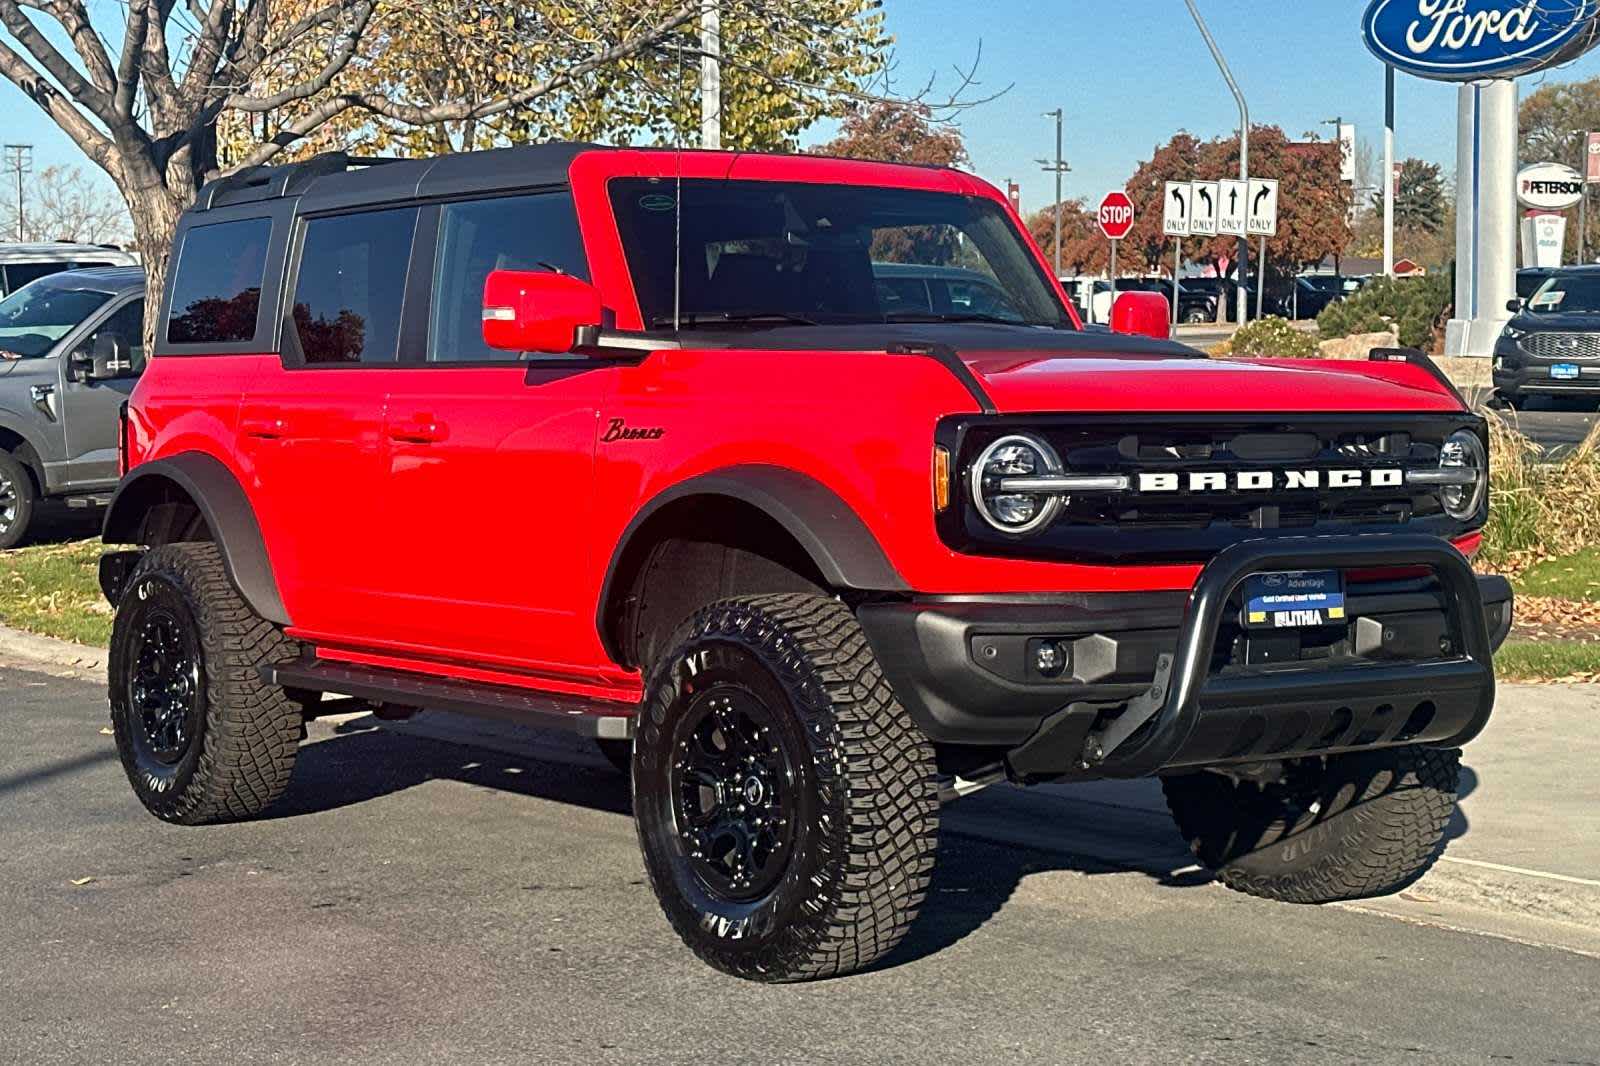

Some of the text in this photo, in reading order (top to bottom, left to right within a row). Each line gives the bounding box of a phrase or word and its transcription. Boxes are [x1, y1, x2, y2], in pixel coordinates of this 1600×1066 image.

[1405, 0, 1539, 54] Ford
[1530, 181, 1583, 194] PETERSON
[1101, 206, 1132, 224] STOP
[1166, 220, 1186, 231] ONLY
[1193, 219, 1214, 231] ONLY
[1221, 218, 1242, 230] ONLY
[1250, 218, 1272, 230] ONLY
[600, 418, 666, 442] Bronco
[1139, 469, 1403, 491] BRONCO
[1287, 579, 1325, 588] Advantage
[1285, 609, 1323, 626] LITHIA
